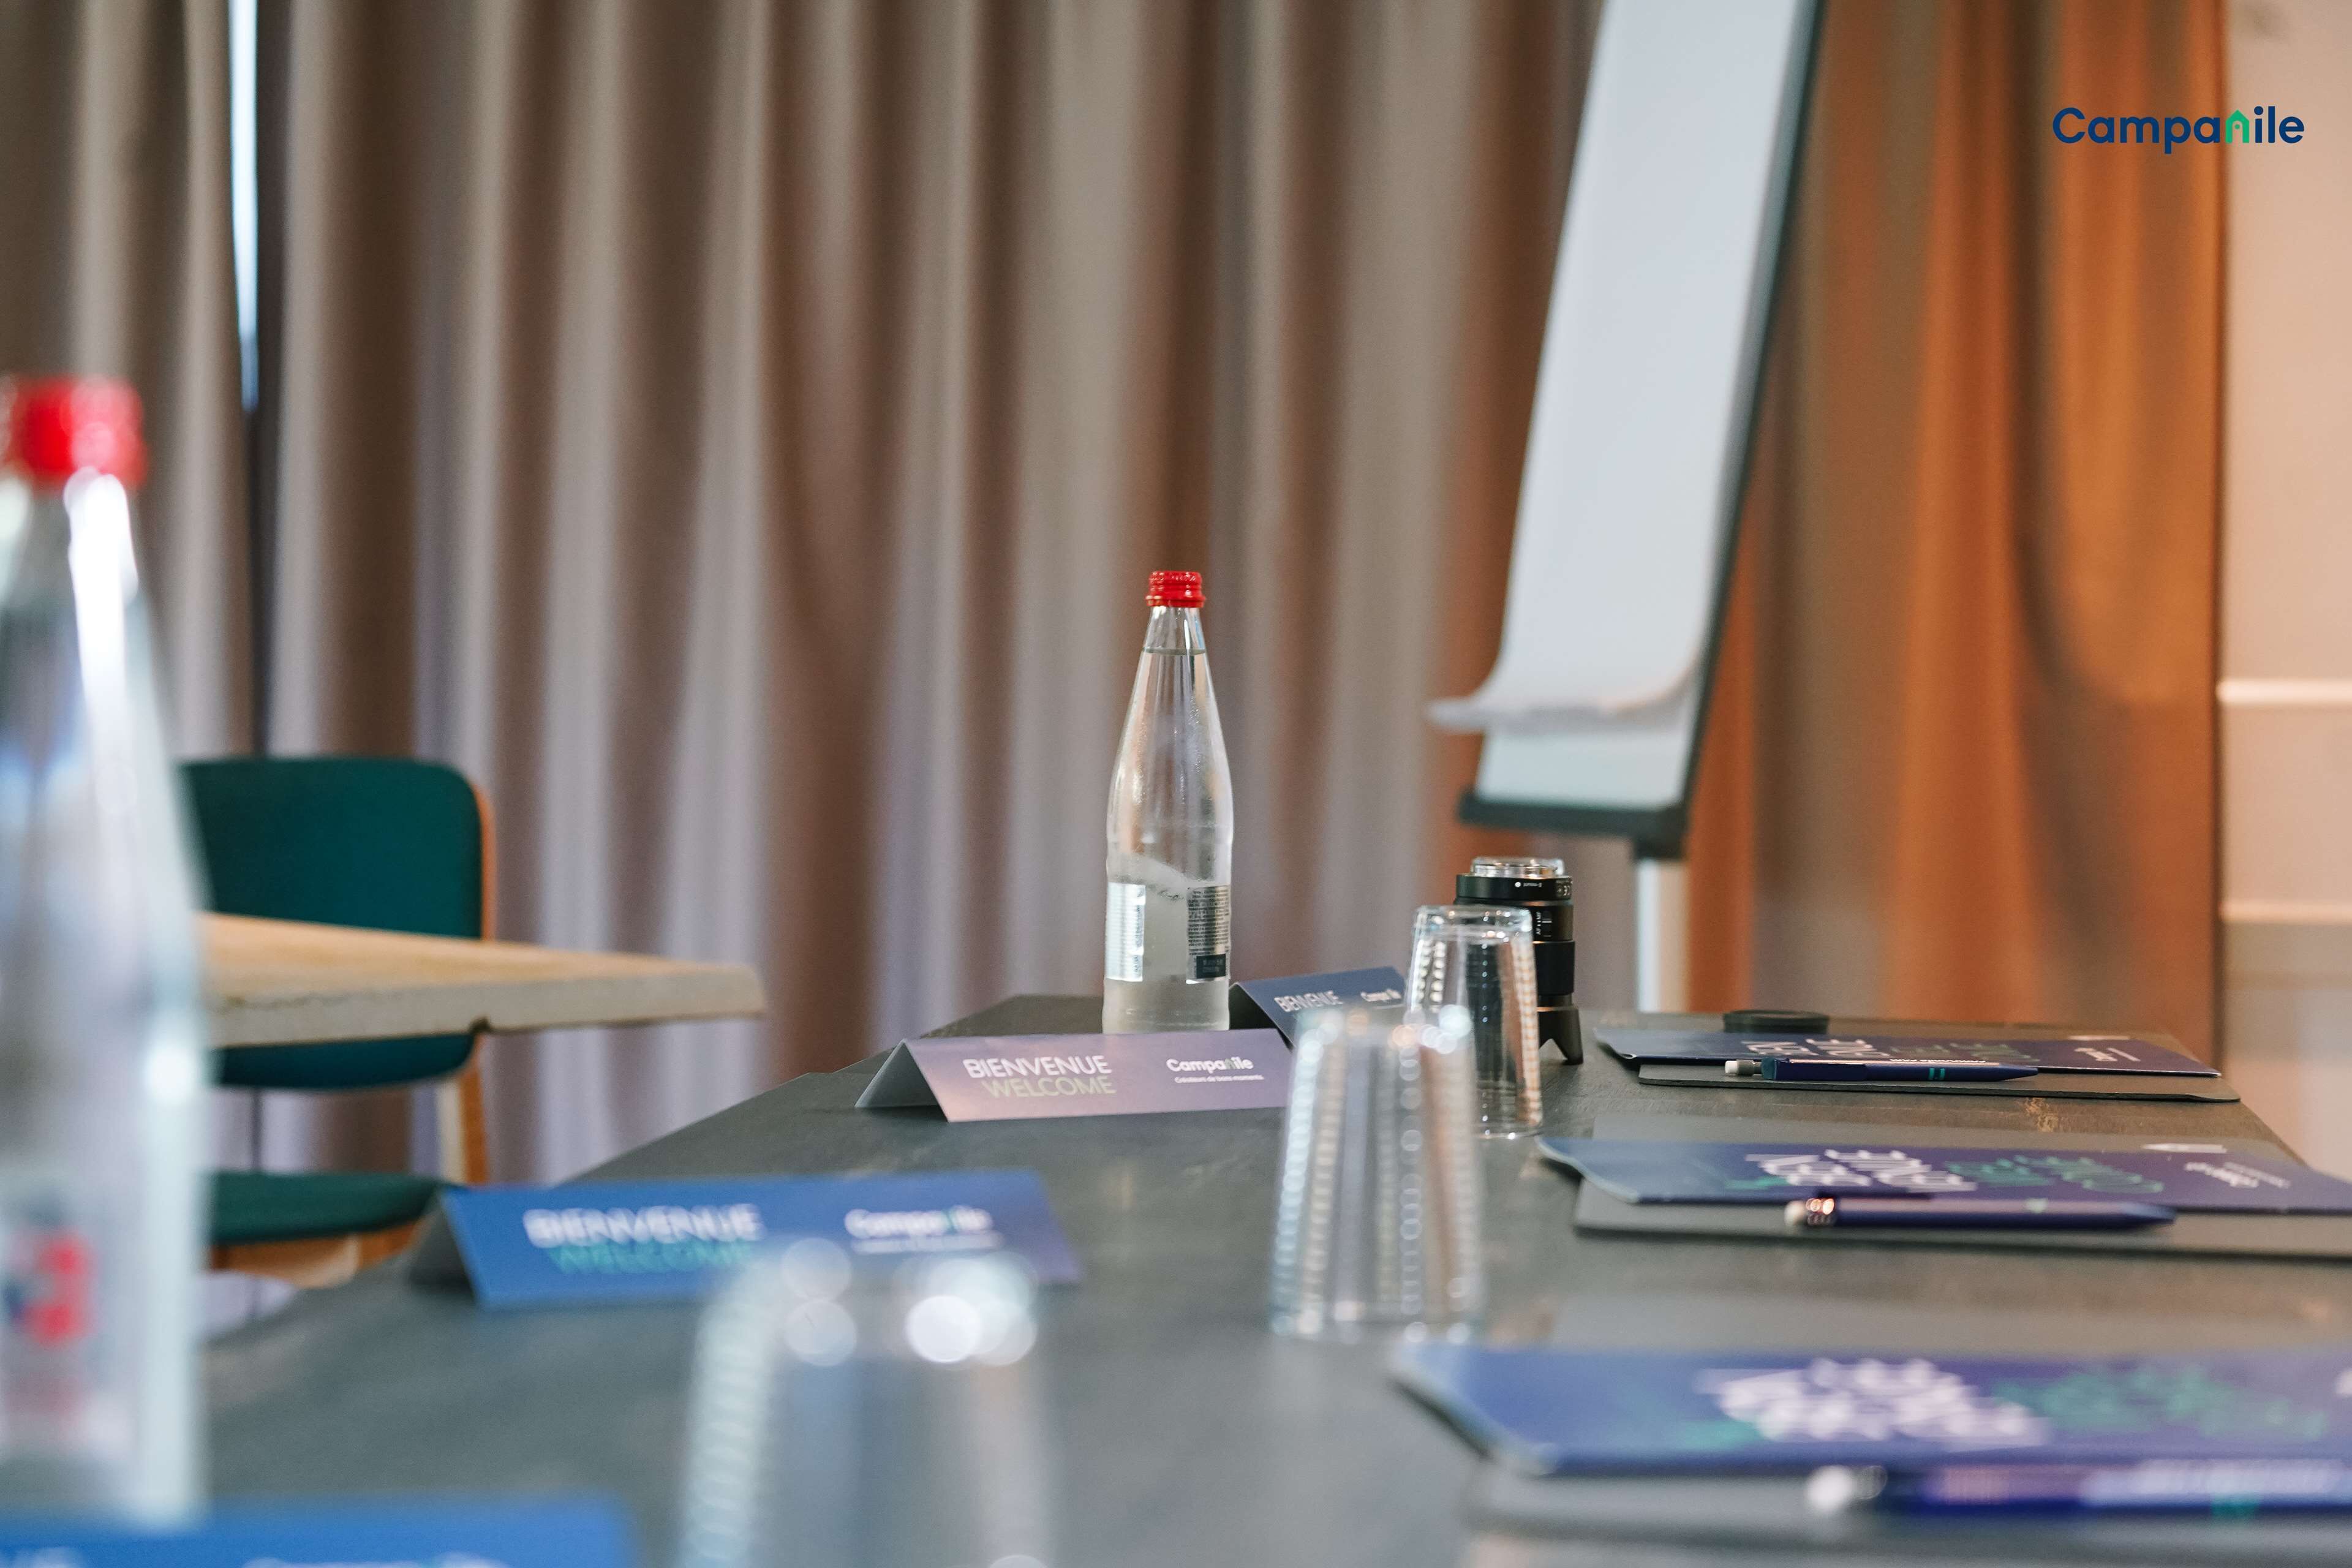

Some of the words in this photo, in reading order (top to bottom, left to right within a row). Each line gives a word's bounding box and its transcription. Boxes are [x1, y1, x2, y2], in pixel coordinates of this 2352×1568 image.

[962, 1055, 1113, 1079] BIENVENUE
[1166, 1056, 1254, 1074] Campanile
[981, 1075, 1117, 1098] WELCOME
